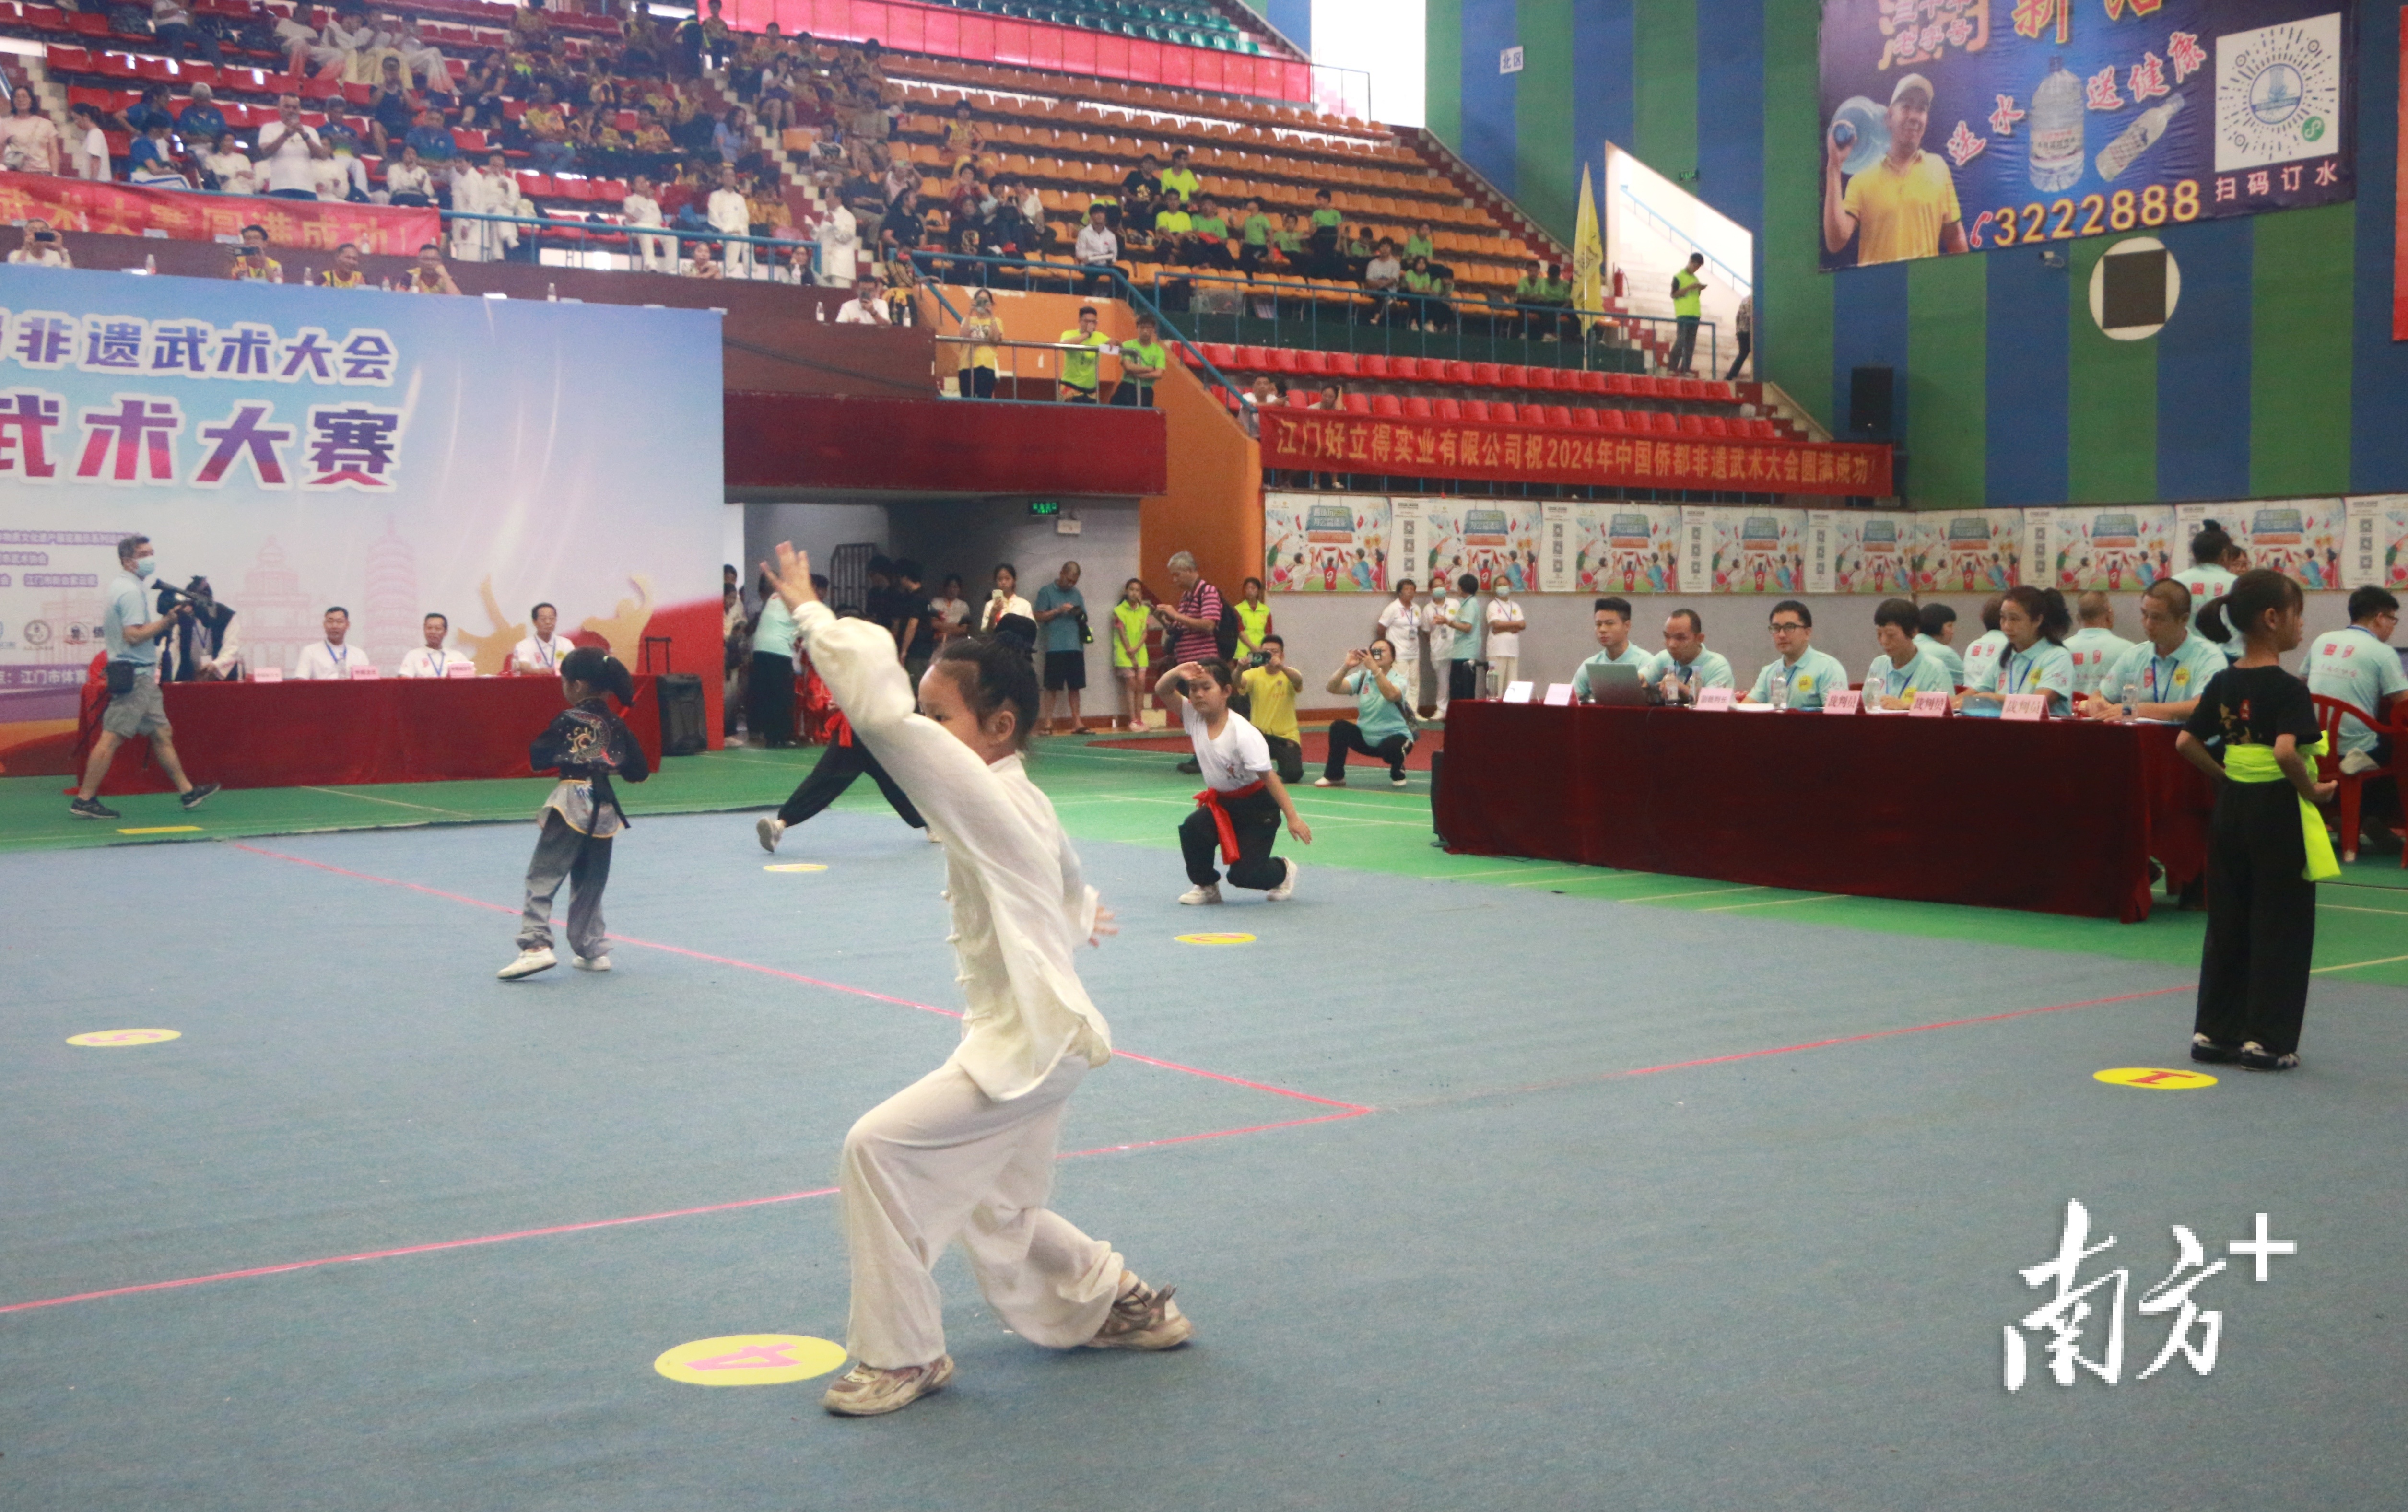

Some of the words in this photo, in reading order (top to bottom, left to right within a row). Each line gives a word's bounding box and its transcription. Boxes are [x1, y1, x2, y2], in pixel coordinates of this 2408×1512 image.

[1893, 18, 1973, 55] 老字号
[2215, 160, 2338, 202] 扫码订水
[1993, 178, 2201, 247] 3222888
[0, 316, 392, 381] 非遗武术大会
[1326, 571, 1333, 582] 9
[1481, 572, 1489, 583] 9
[1828, 695, 1858, 708] 裁判员
[1914, 697, 1944, 711] 裁判员
[2005, 700, 2041, 714] 裁判员
[683, 1342, 802, 1371] 4
